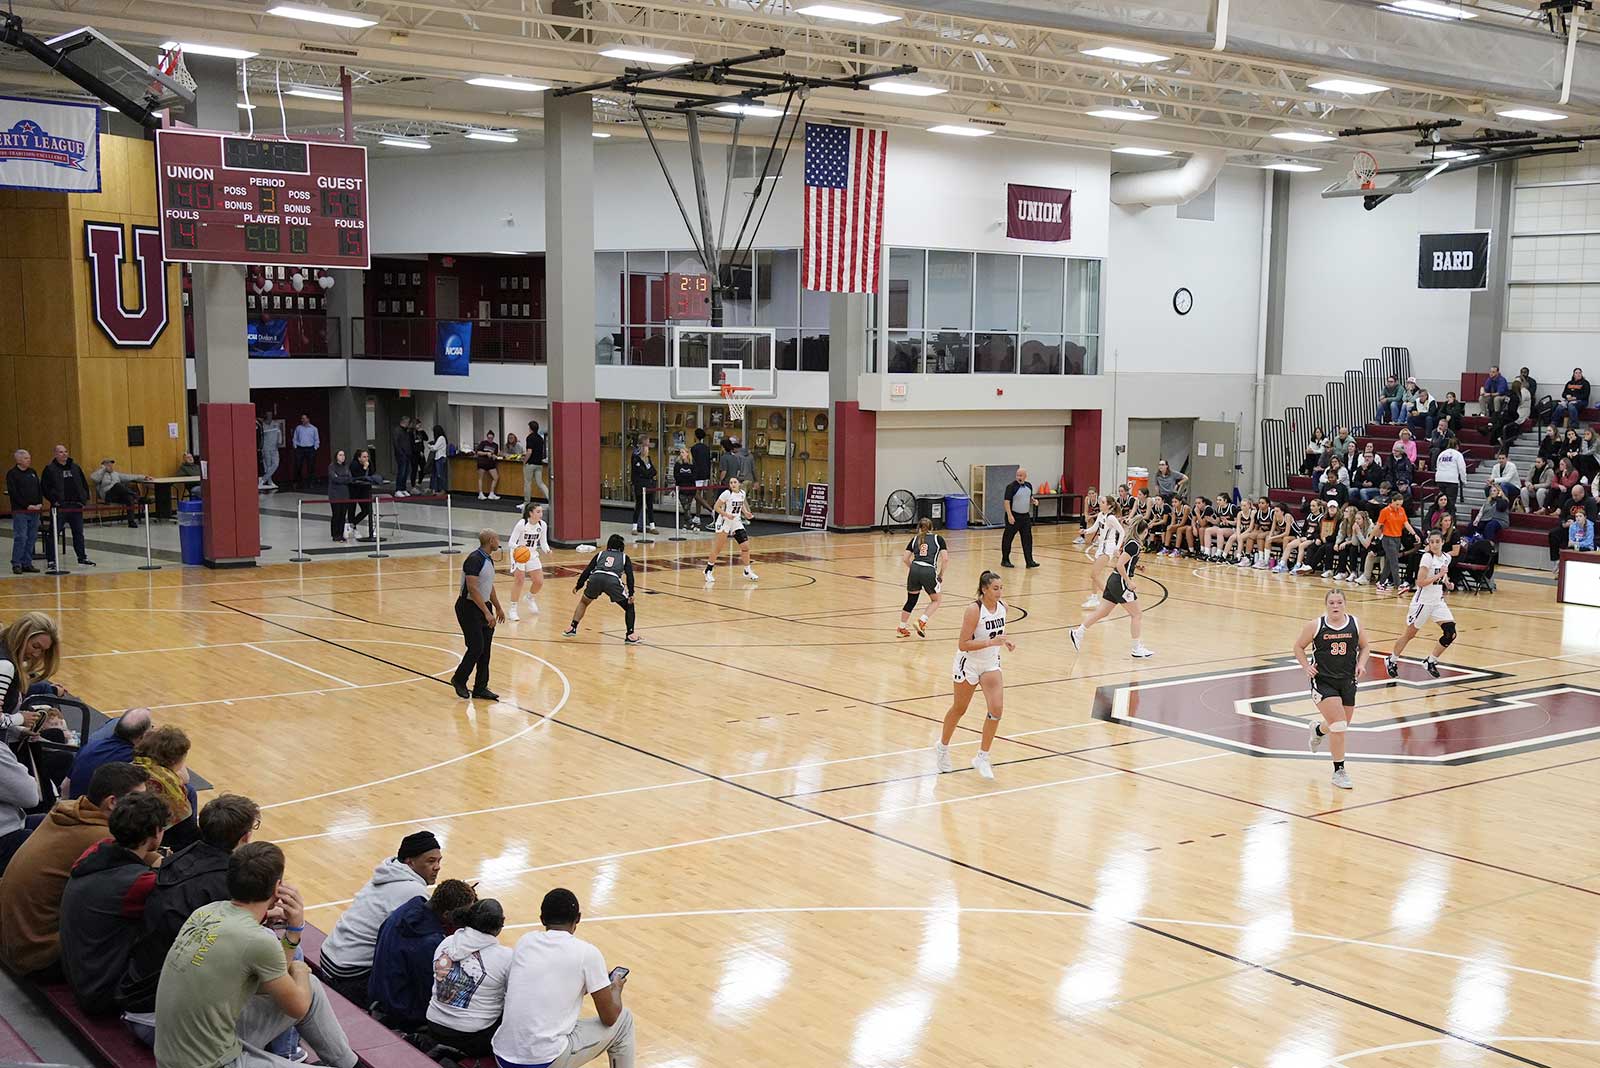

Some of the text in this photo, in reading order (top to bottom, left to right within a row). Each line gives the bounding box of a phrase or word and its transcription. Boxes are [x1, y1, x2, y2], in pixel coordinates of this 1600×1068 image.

[35, 136, 83, 154] LEAGUE
[167, 165, 214, 180] UNION
[249, 177, 286, 188] PERIOD
[317, 176, 363, 190] GUEST
[224, 186, 247, 195] POSS
[288, 190, 311, 200] POSS
[224, 201, 253, 210] BONUS
[263, 188, 275, 212] 3
[166, 209, 200, 220] FOULS
[284, 204, 311, 213] BONUS
[1017, 199, 1063, 223] UNION
[243, 213, 311, 226] PLAYER FOUL
[335, 219, 365, 229] FOULS
[179, 223, 195, 246] 4
[347, 230, 360, 255] 5
[1432, 250, 1474, 271] BARD
[84, 220, 169, 349] U
[680, 277, 707, 291] 2:13
[445, 347, 463, 356] NCAA
[985, 617, 1005, 630] UNION
[1330, 641, 1347, 656] 33
